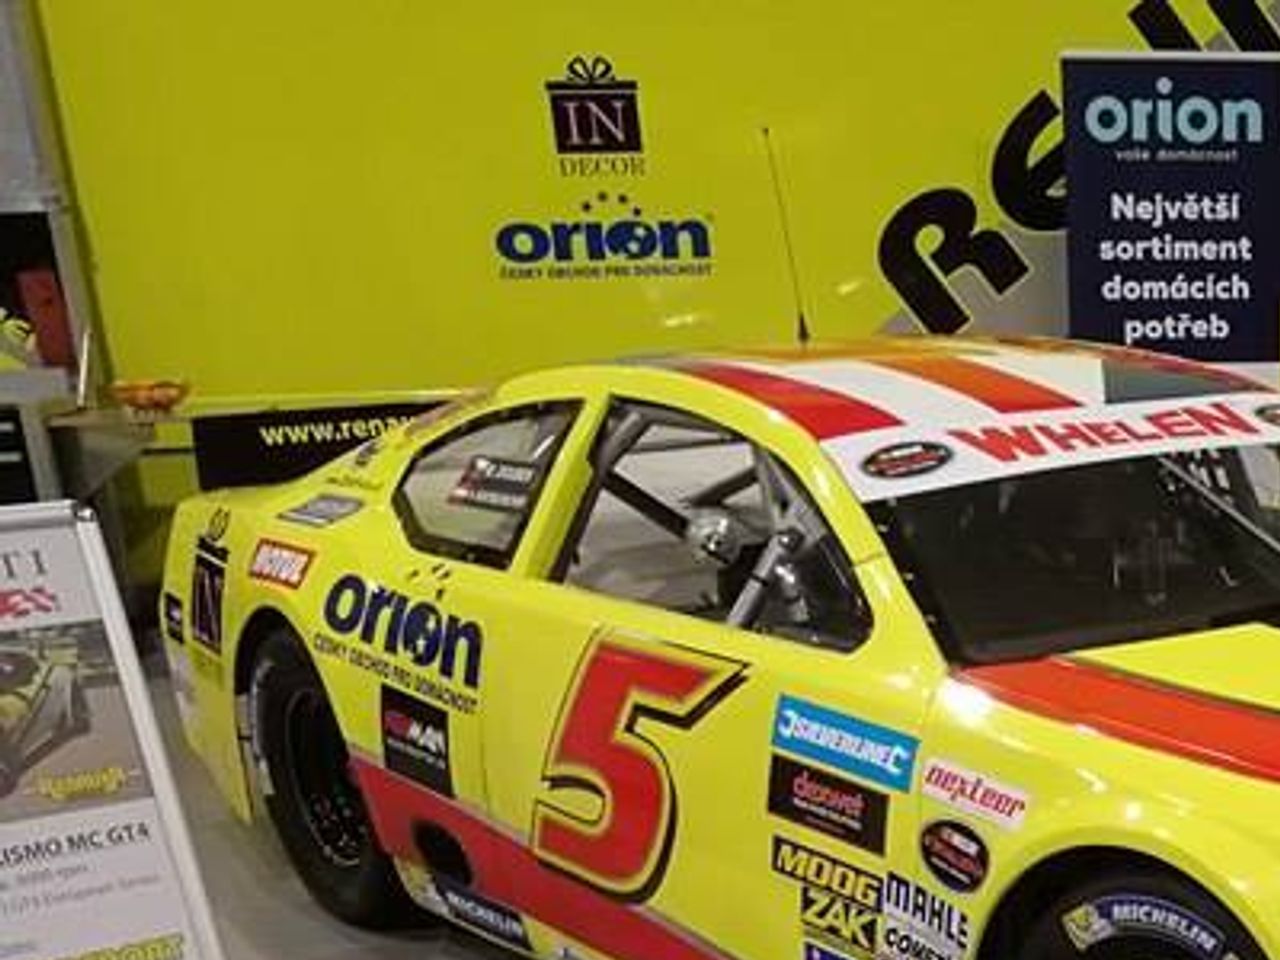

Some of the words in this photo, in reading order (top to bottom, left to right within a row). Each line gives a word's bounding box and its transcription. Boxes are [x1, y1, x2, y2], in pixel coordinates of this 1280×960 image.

[561, 100, 628, 147] IN
[1084, 77, 1263, 143] orion
[1110, 192, 1241, 228] Největší
[496, 219, 713, 264] orion
[1099, 234, 1253, 261] sortiment
[1101, 274, 1250, 301] domácích
[1124, 312, 1230, 346] potřeb
[947, 401, 1262, 465] WHELEN
[323, 573, 484, 690] orion
[529, 625, 751, 904] 5
[776, 843, 880, 907] MOOG
[802, 886, 877, 953] ZAK
[885, 870, 969, 949] MAHLE
[1112, 902, 1218, 952] MICHELIN
